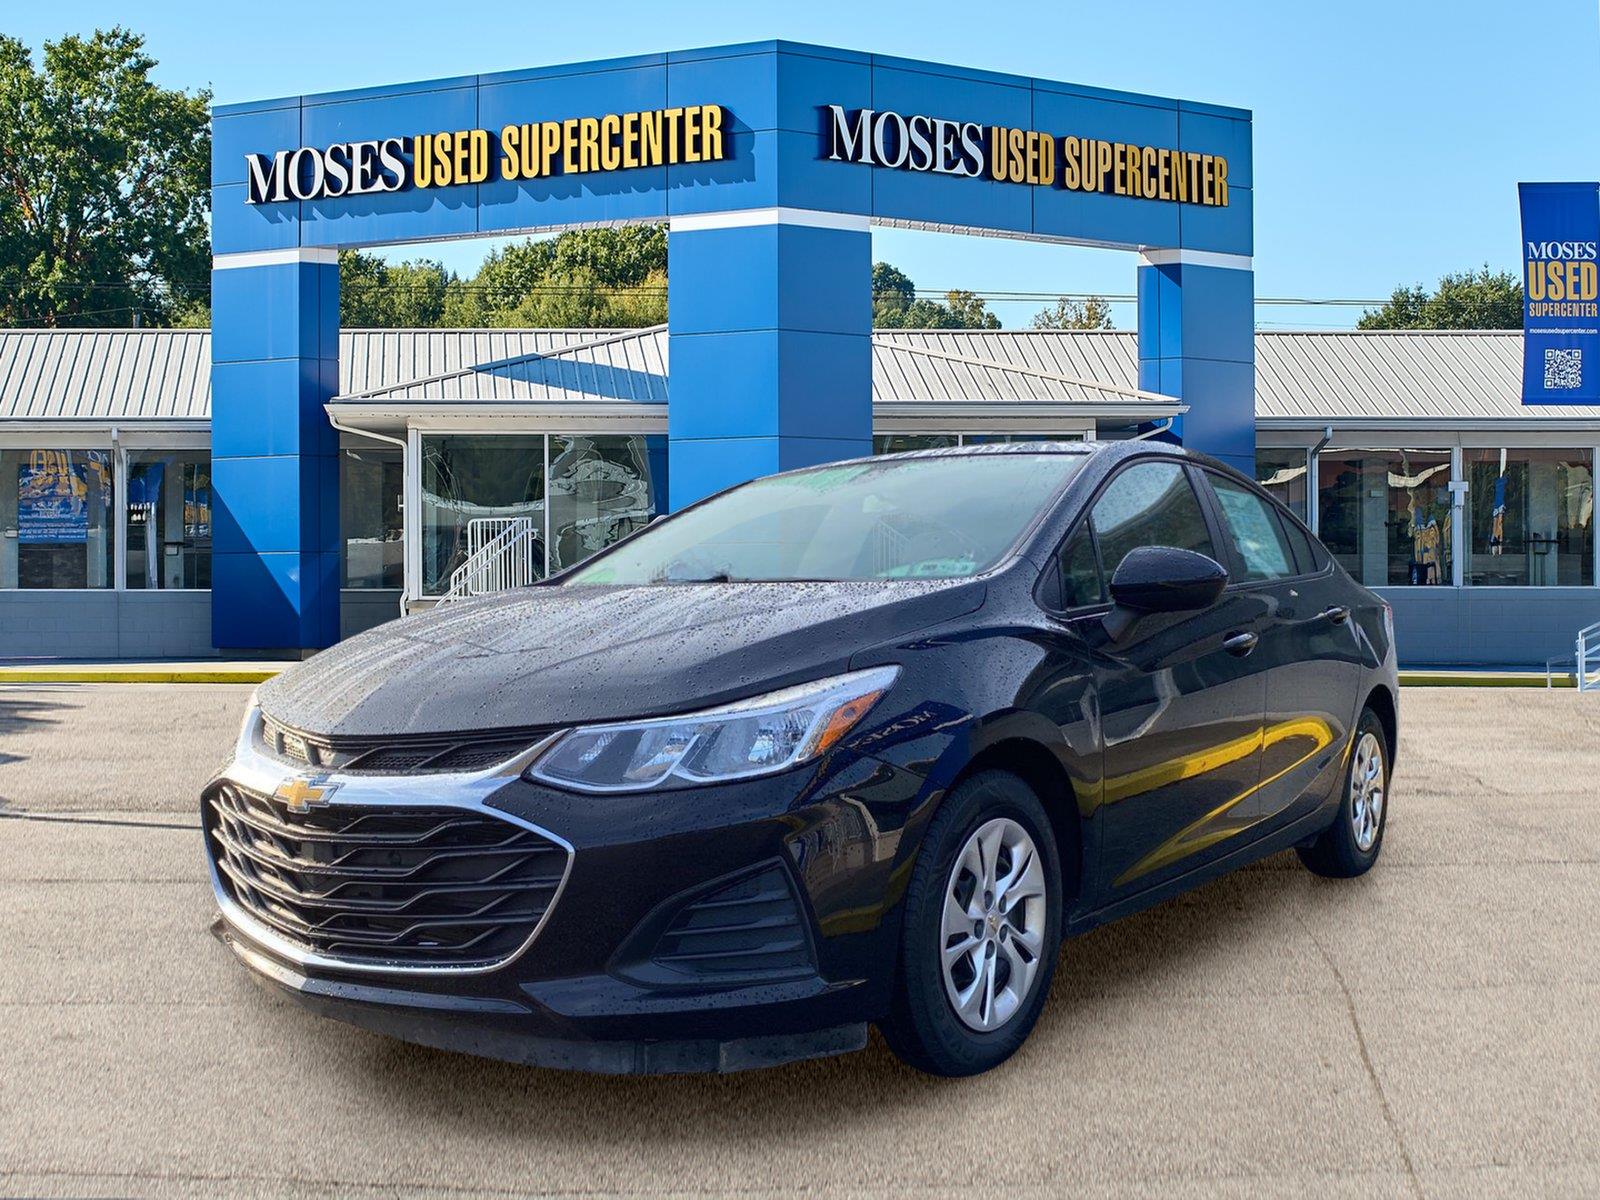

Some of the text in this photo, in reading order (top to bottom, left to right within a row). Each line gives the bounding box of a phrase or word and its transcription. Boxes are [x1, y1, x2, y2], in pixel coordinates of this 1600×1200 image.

[244, 104, 723, 204] MOSES USED SUPERCENTER
[827, 104, 1229, 207] MOSES USED SUPERCENTER
[1527, 241, 1597, 260] MOSES
[1528, 261, 1598, 301] USED
[1529, 302, 1598, 318] SUPERCENTER
